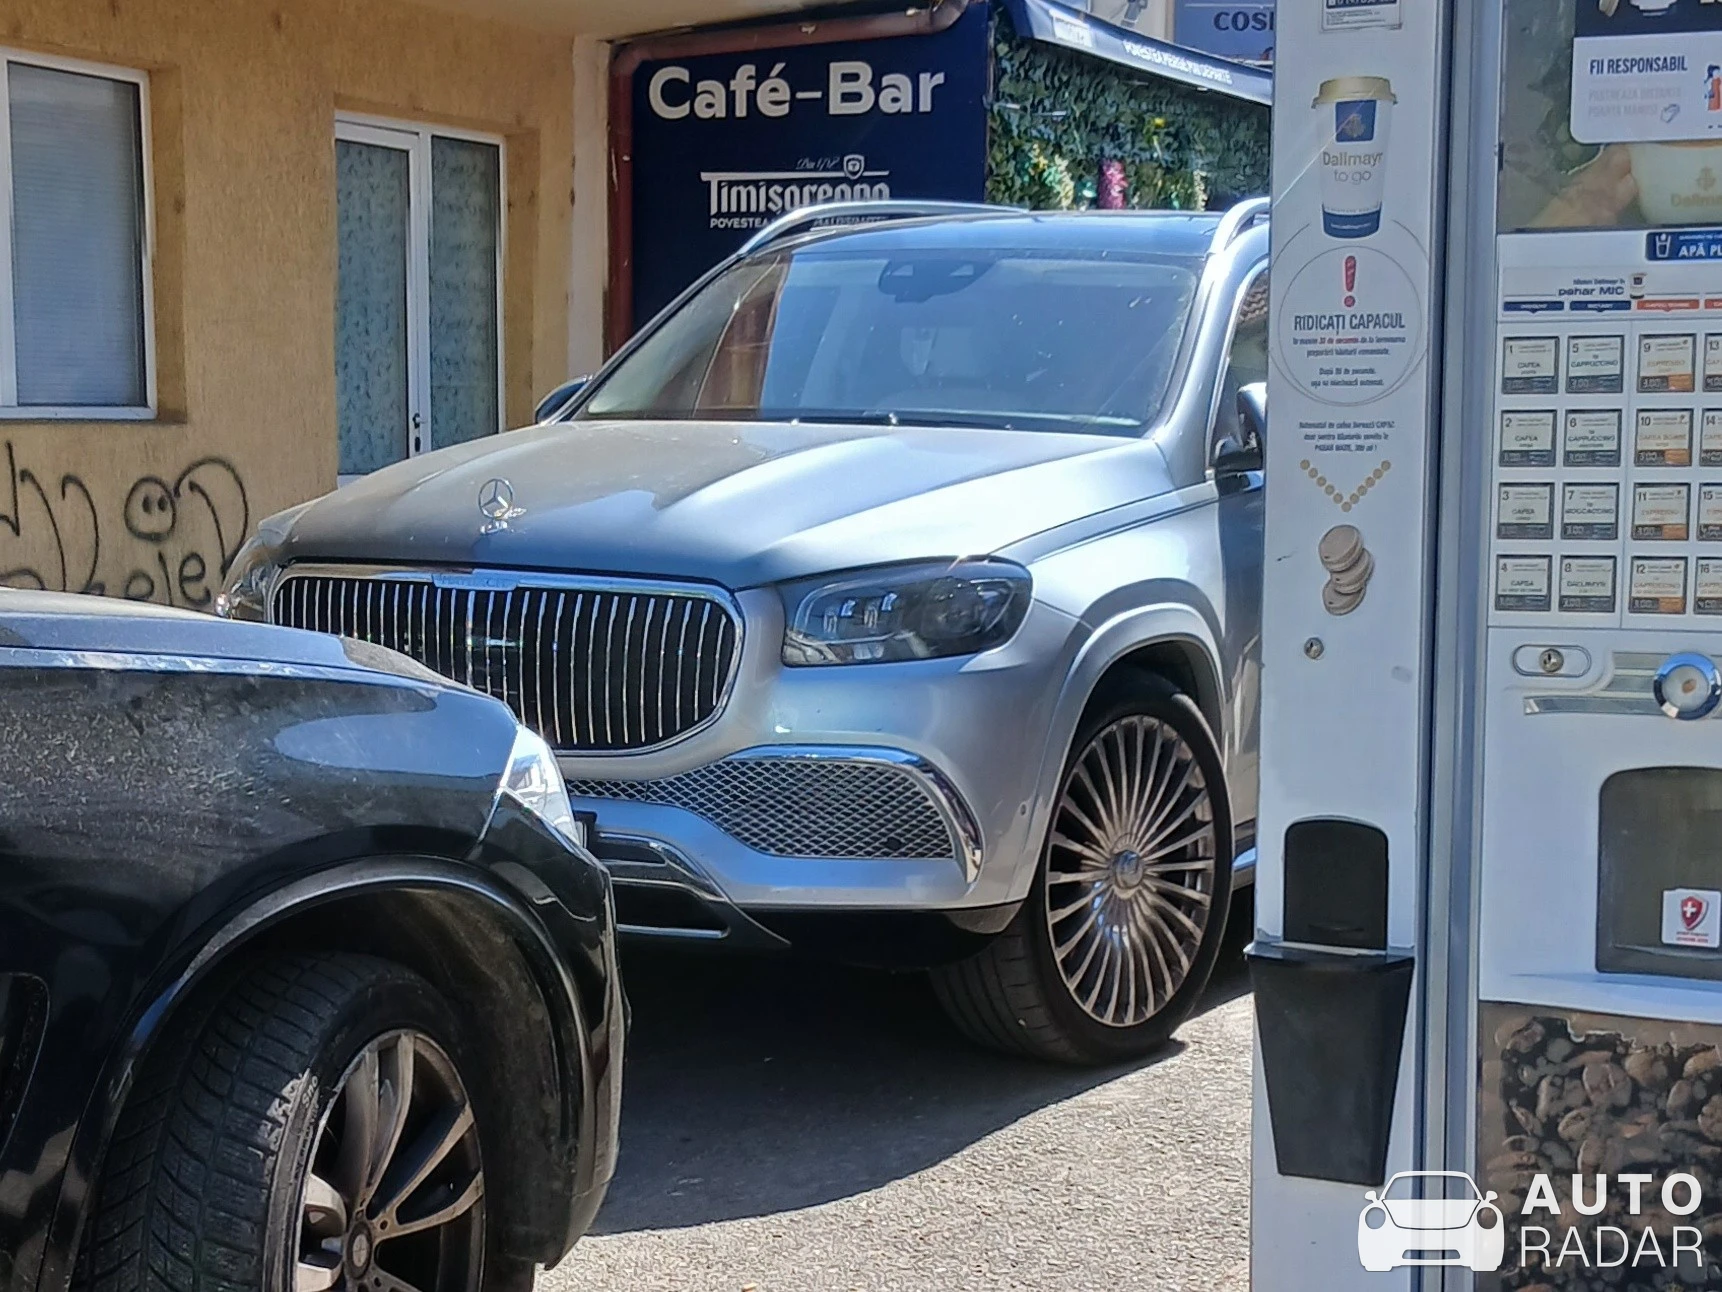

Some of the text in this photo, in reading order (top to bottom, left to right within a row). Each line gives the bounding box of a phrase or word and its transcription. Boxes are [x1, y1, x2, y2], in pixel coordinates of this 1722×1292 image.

[1589, 55, 1689, 75] FII RESPONSABIL
[648, 60, 946, 120] Café-Bar
[1322, 151, 1384, 168] Dallmayr
[1333, 169, 1372, 186] to go
[1558, 285, 1625, 297] pahar MIC
[1349, 312, 1406, 330] CAPACUL
